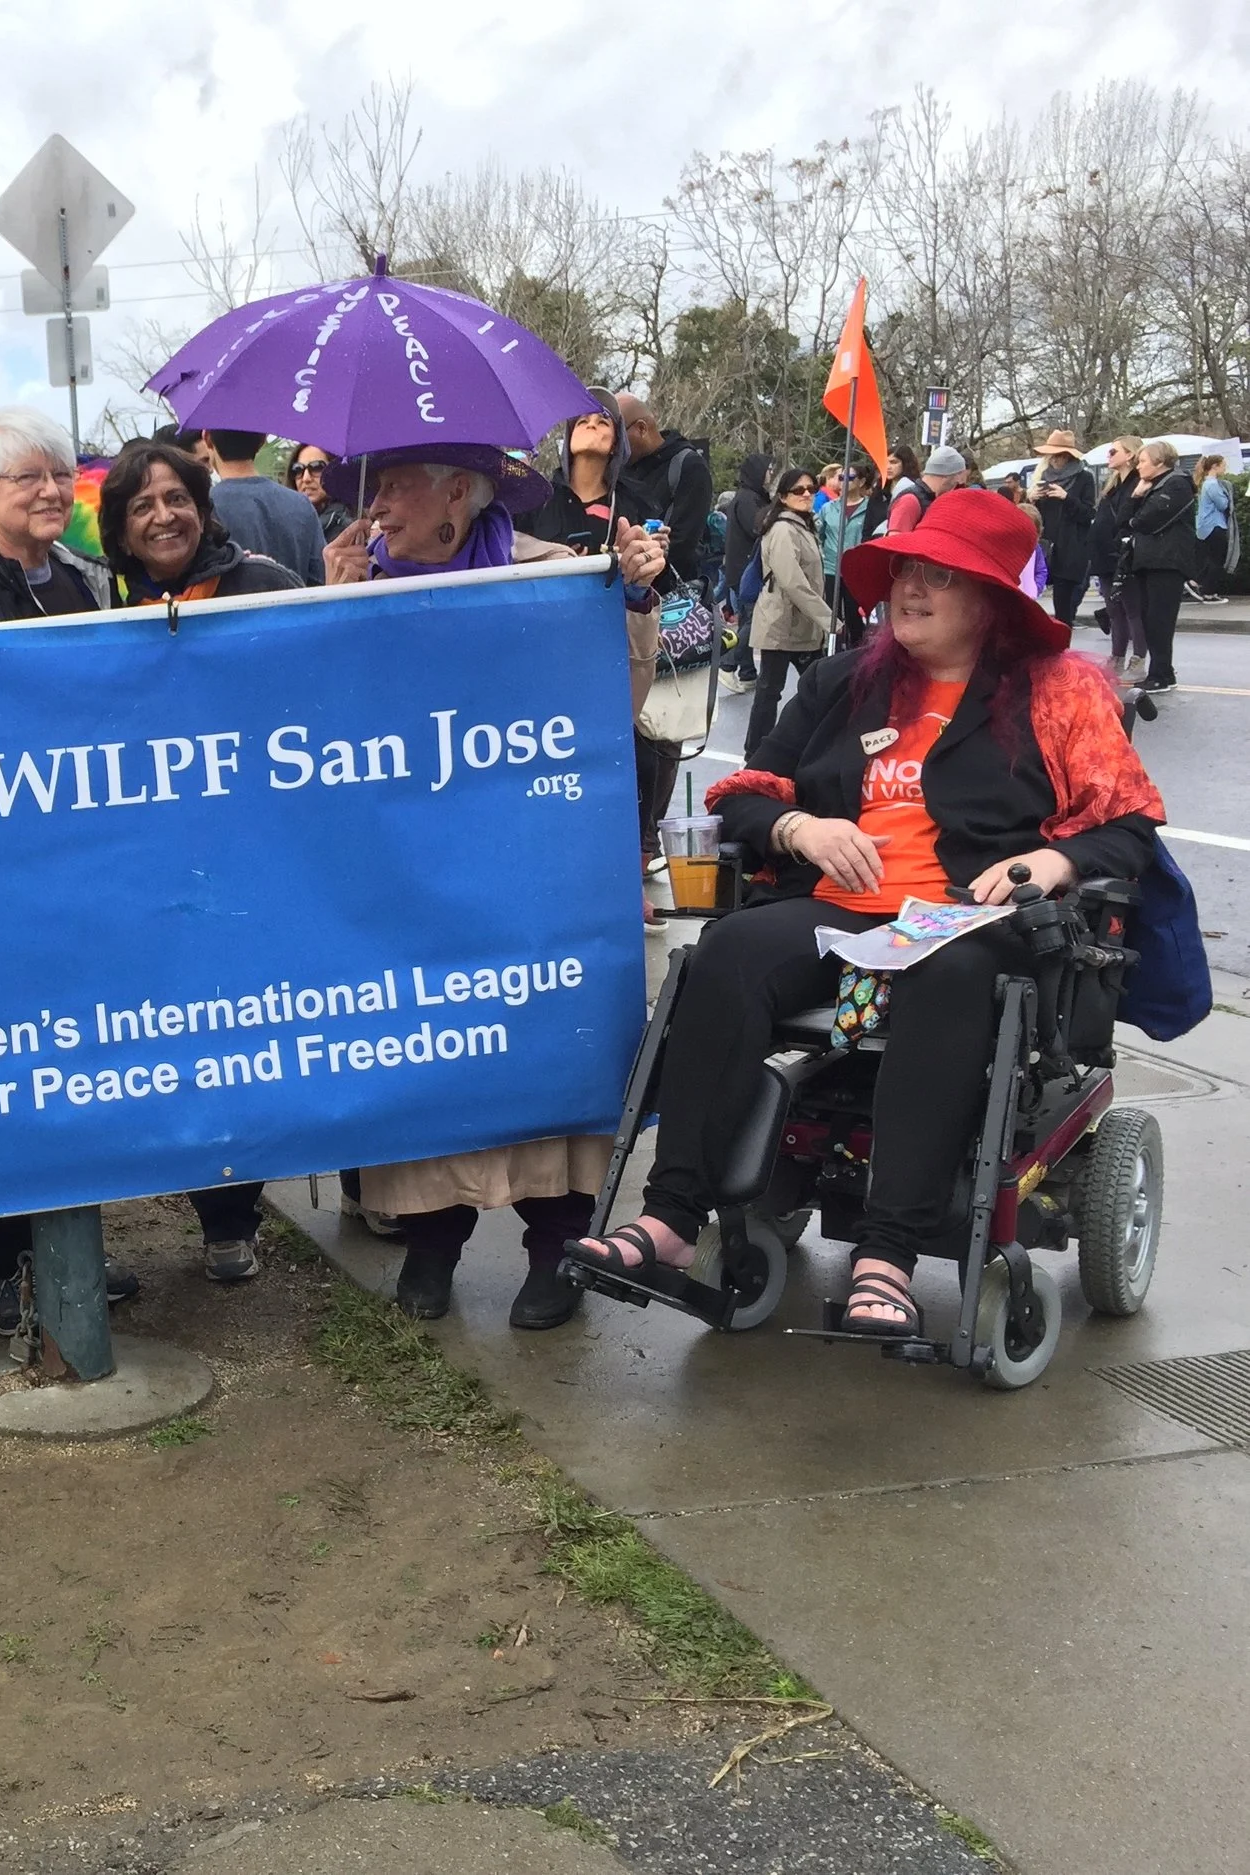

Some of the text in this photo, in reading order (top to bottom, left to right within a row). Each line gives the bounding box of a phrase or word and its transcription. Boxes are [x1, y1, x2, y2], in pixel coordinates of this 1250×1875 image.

[377, 293, 445, 423] PEACE
[266, 725, 411, 790] San
[429, 709, 576, 792] Jose
[525, 772, 583, 801] .org
[95, 969, 398, 1044] International
[412, 956, 584, 1006] League
[32, 1062, 179, 1109] Peace
[194, 1040, 283, 1089] and
[296, 1021, 508, 1077] Freedom
